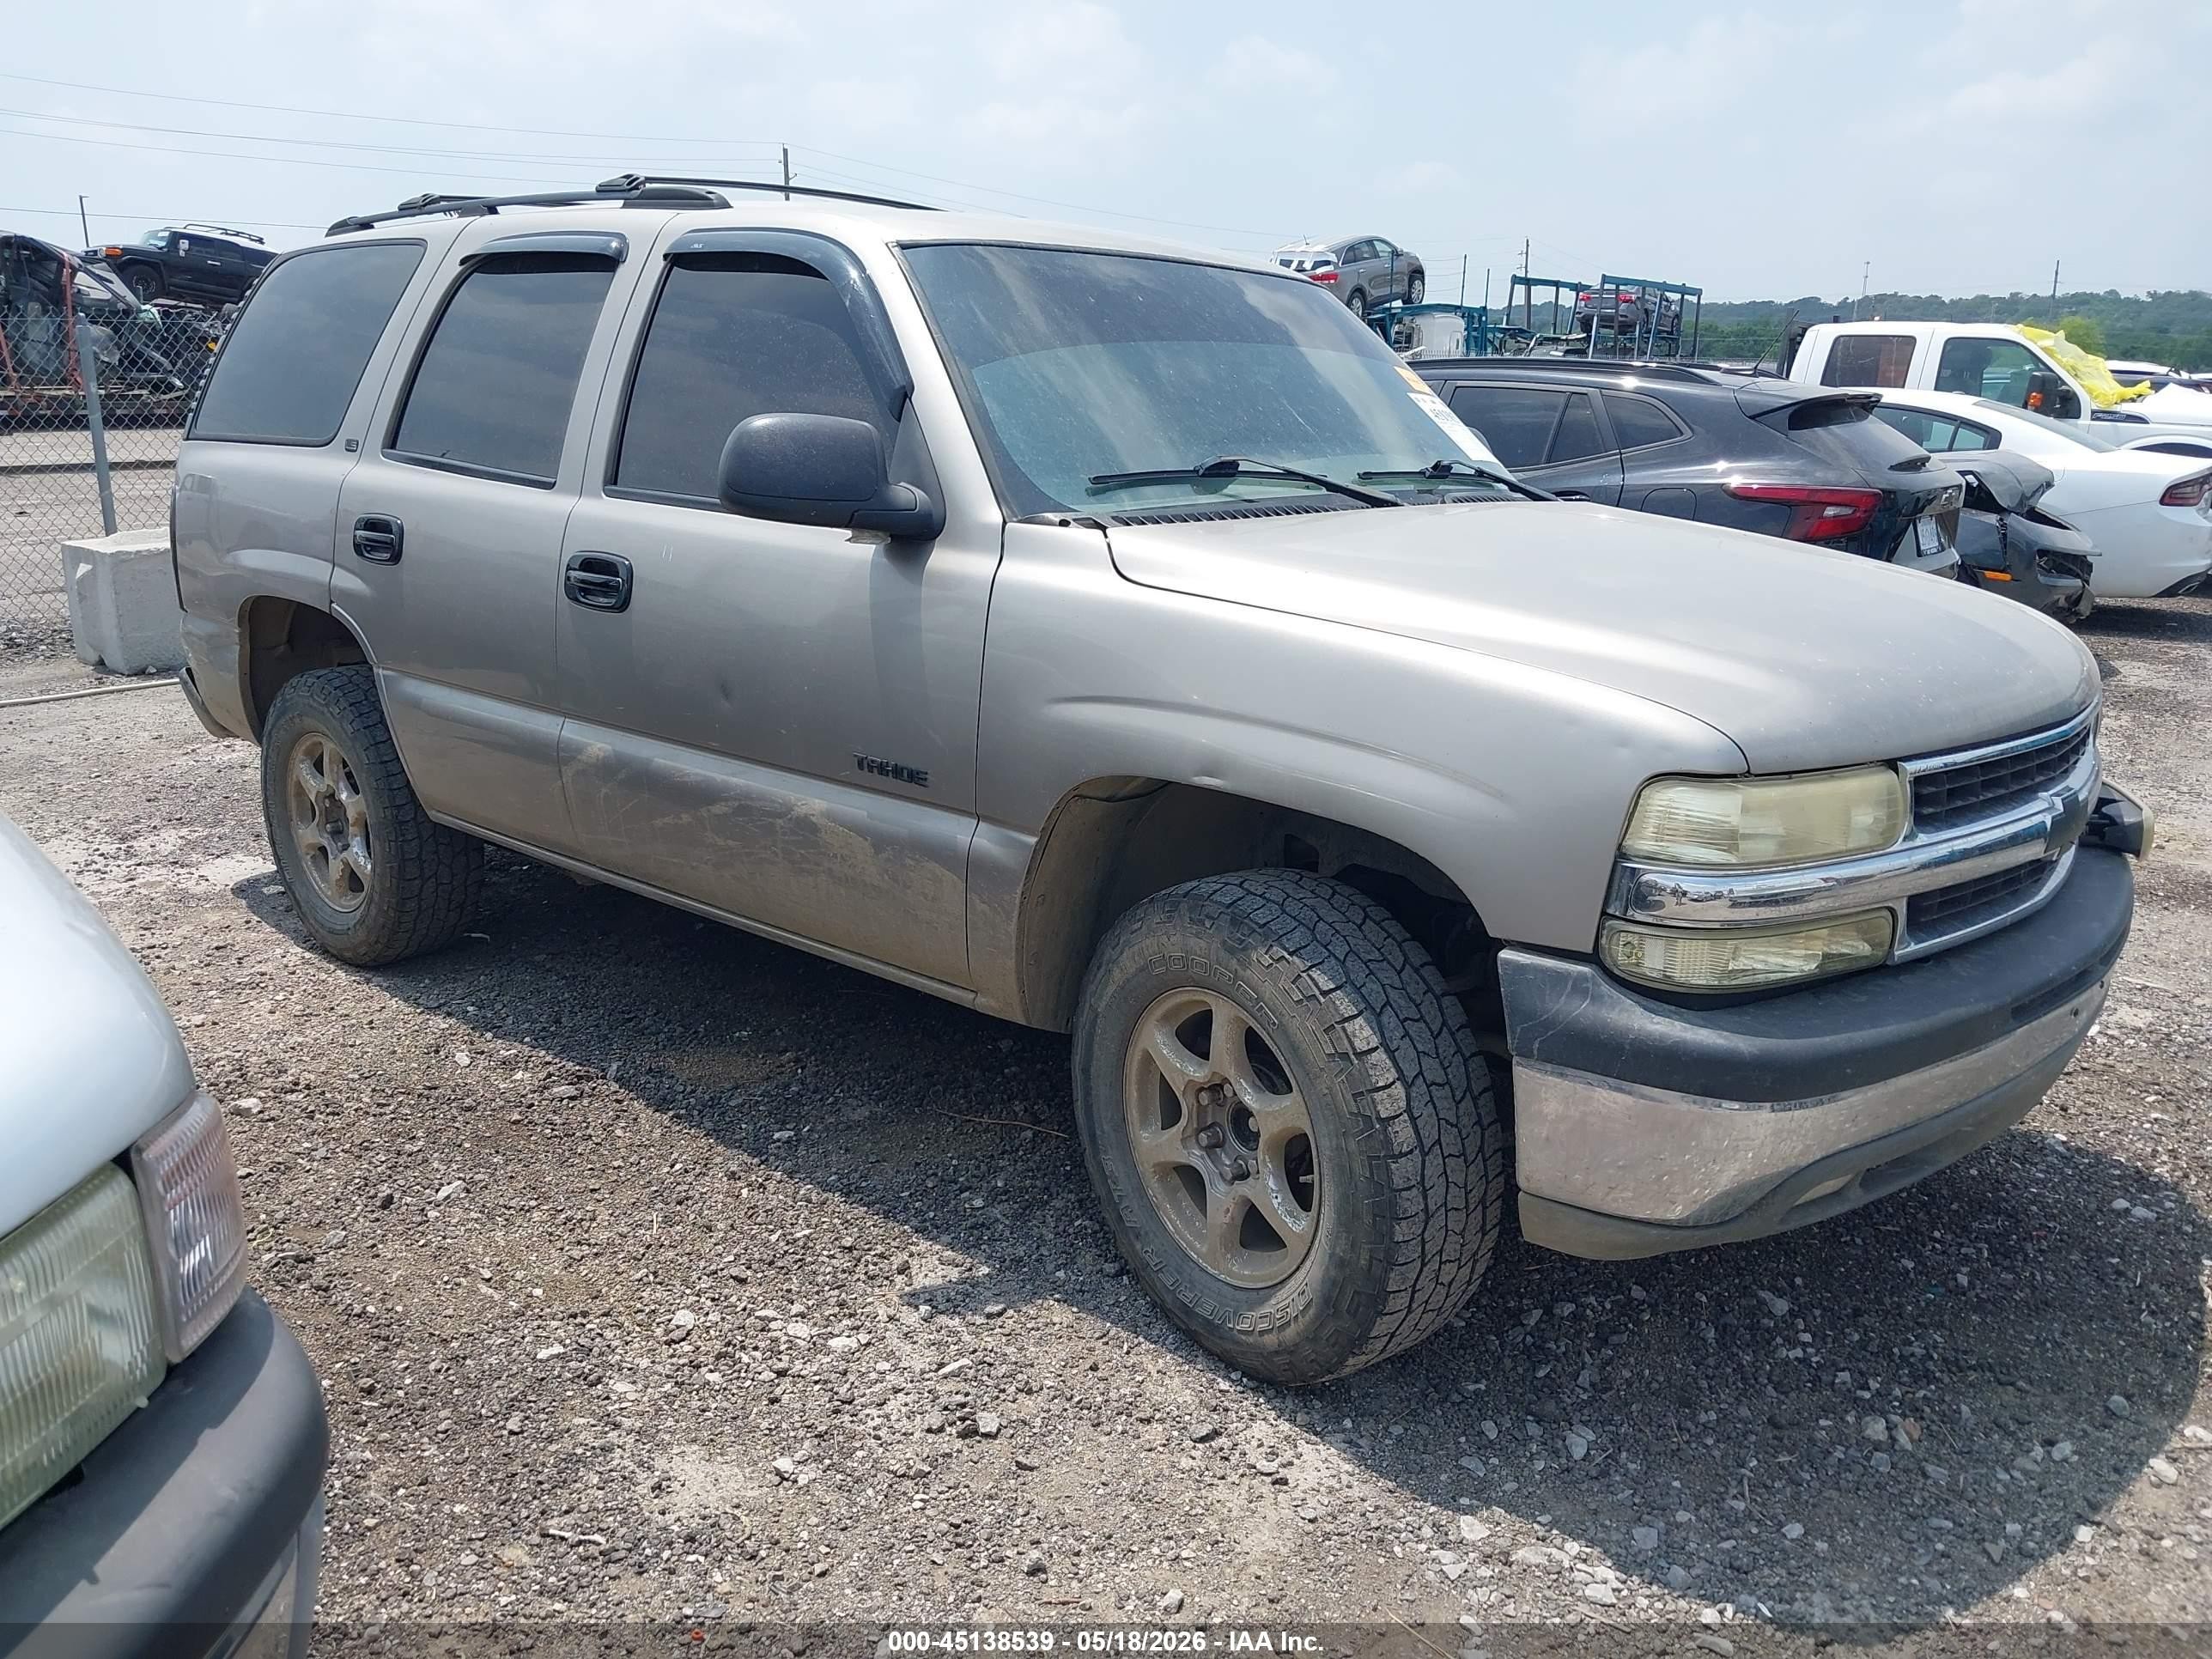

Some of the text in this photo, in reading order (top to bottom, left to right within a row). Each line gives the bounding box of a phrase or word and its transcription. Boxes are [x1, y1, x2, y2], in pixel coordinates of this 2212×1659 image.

[854, 752, 930, 788] TAHOE
[1148, 953, 1278, 1030] COOPER
[1142, 1244, 1314, 1331] DISCOVERER
